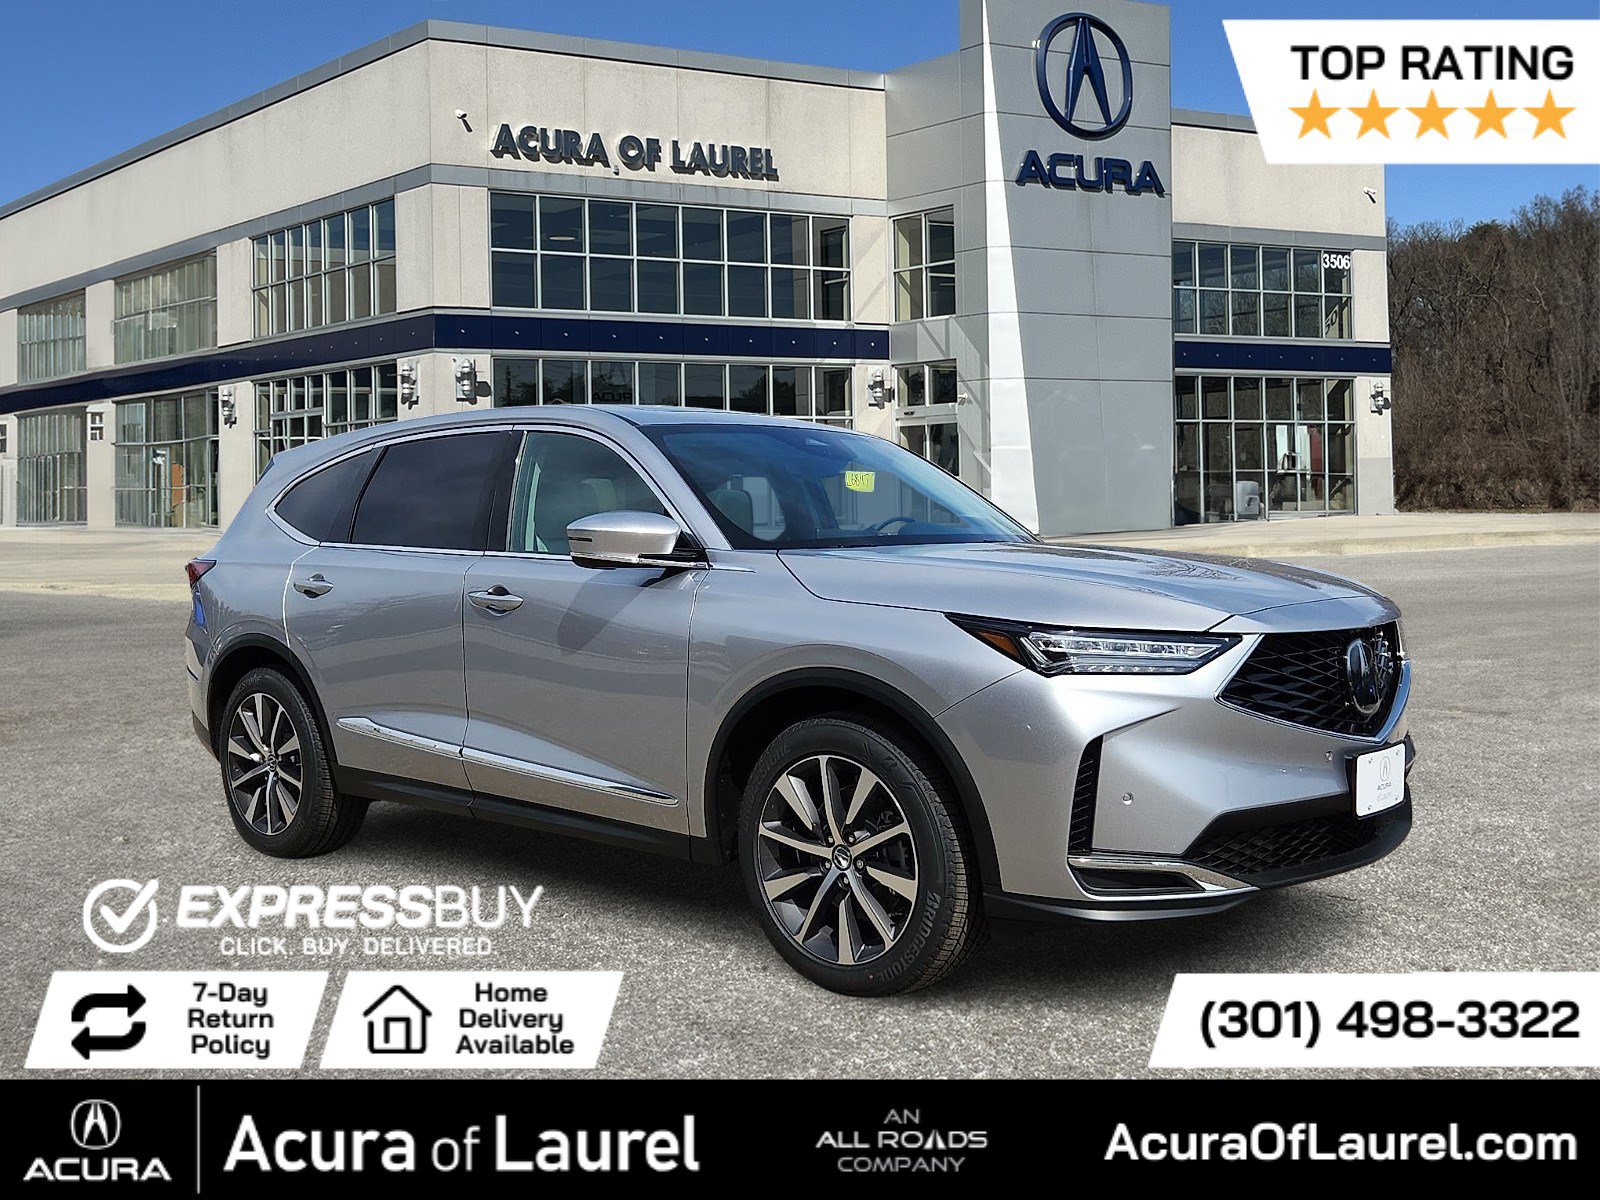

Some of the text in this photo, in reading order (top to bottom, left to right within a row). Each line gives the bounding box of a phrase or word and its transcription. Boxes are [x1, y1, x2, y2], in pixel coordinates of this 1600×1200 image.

[491, 123, 779, 181] ACURA OF LAUREL
[1016, 150, 1165, 197] ACURA
[1322, 253, 1351, 270] 3506
